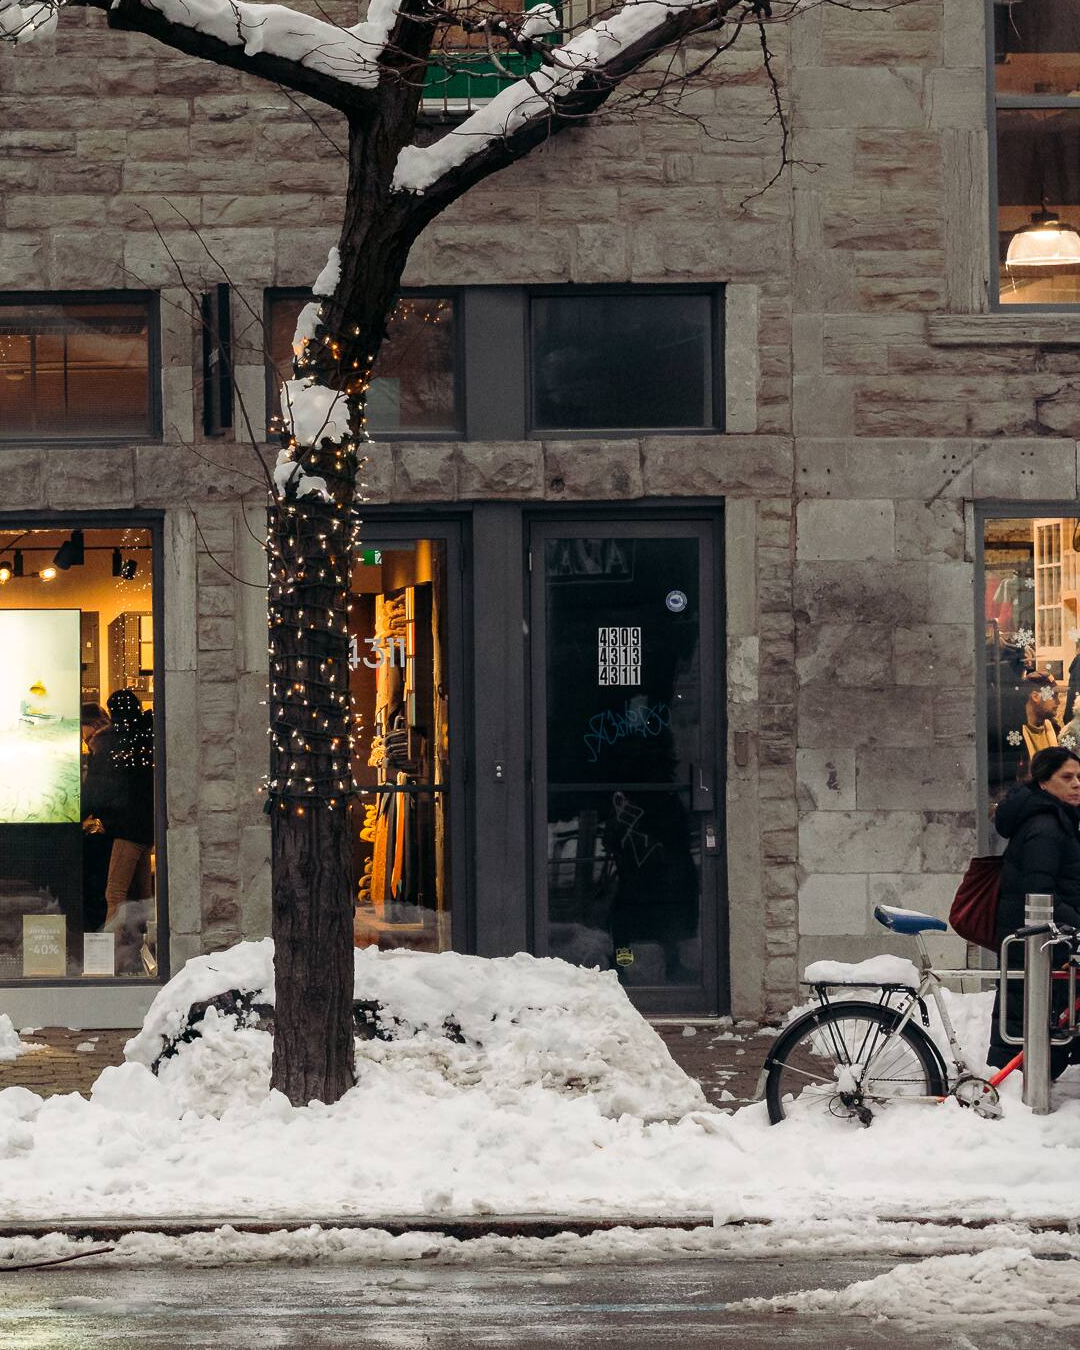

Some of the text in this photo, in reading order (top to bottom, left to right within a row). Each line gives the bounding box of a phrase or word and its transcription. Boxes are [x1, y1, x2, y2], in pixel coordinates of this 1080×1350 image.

[600, 628, 640, 646] 4309
[600, 647, 640, 665] 4313
[600, 666, 639, 684] 4311
